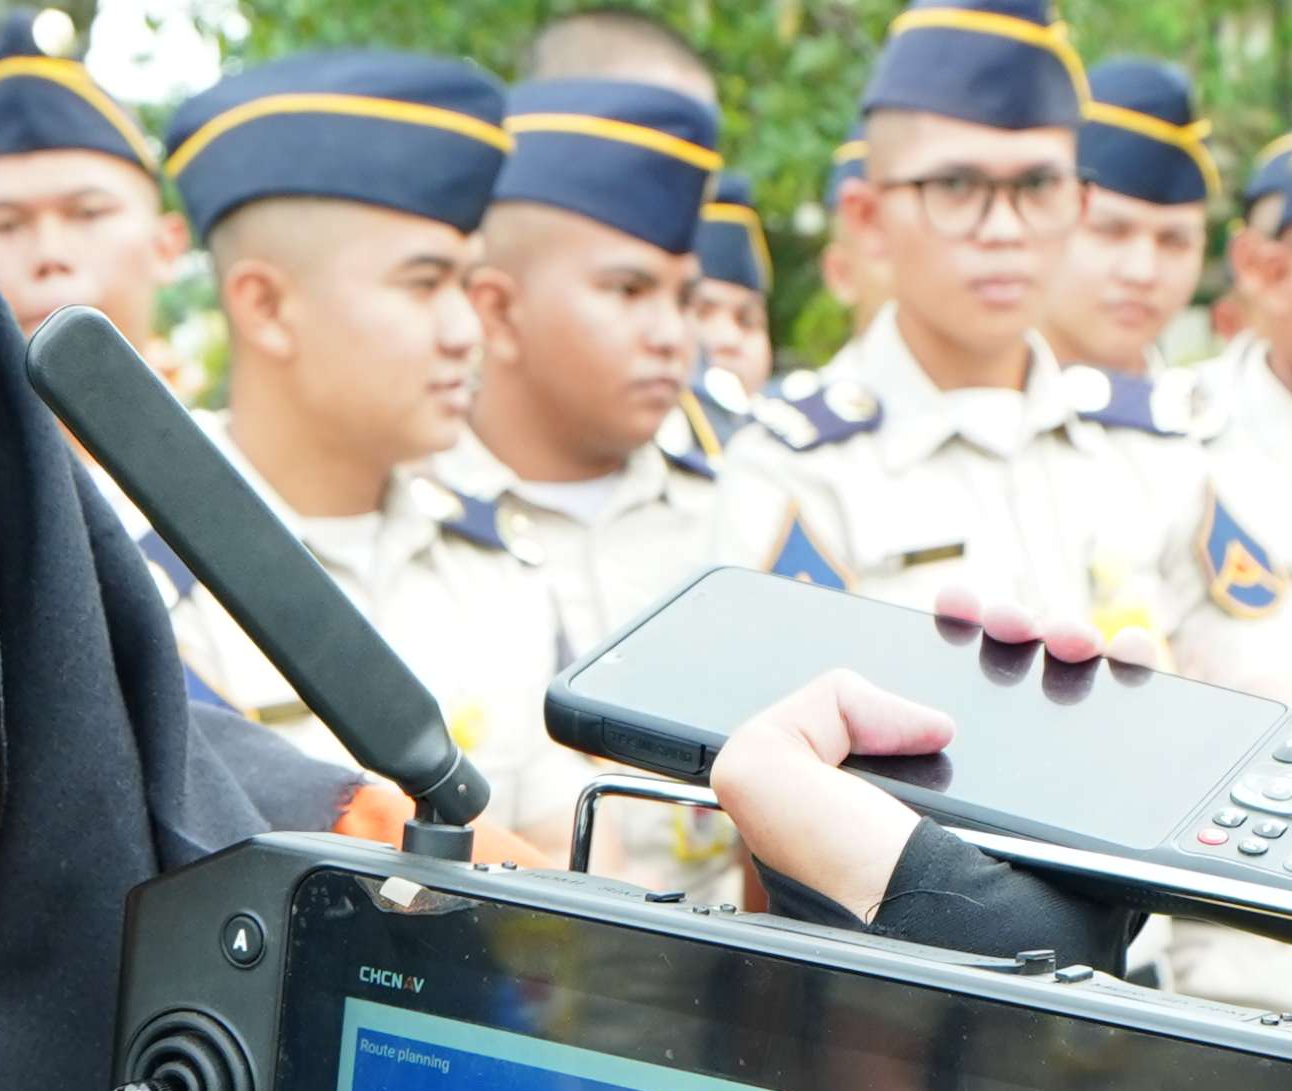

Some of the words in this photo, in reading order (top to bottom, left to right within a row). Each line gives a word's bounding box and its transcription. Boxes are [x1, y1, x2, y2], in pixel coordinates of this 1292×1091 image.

[232, 928, 248, 952] A
[358, 965, 425, 994] CHCNAV
[360, 1038, 396, 1058] Route
[397, 1048, 450, 1074] planning
